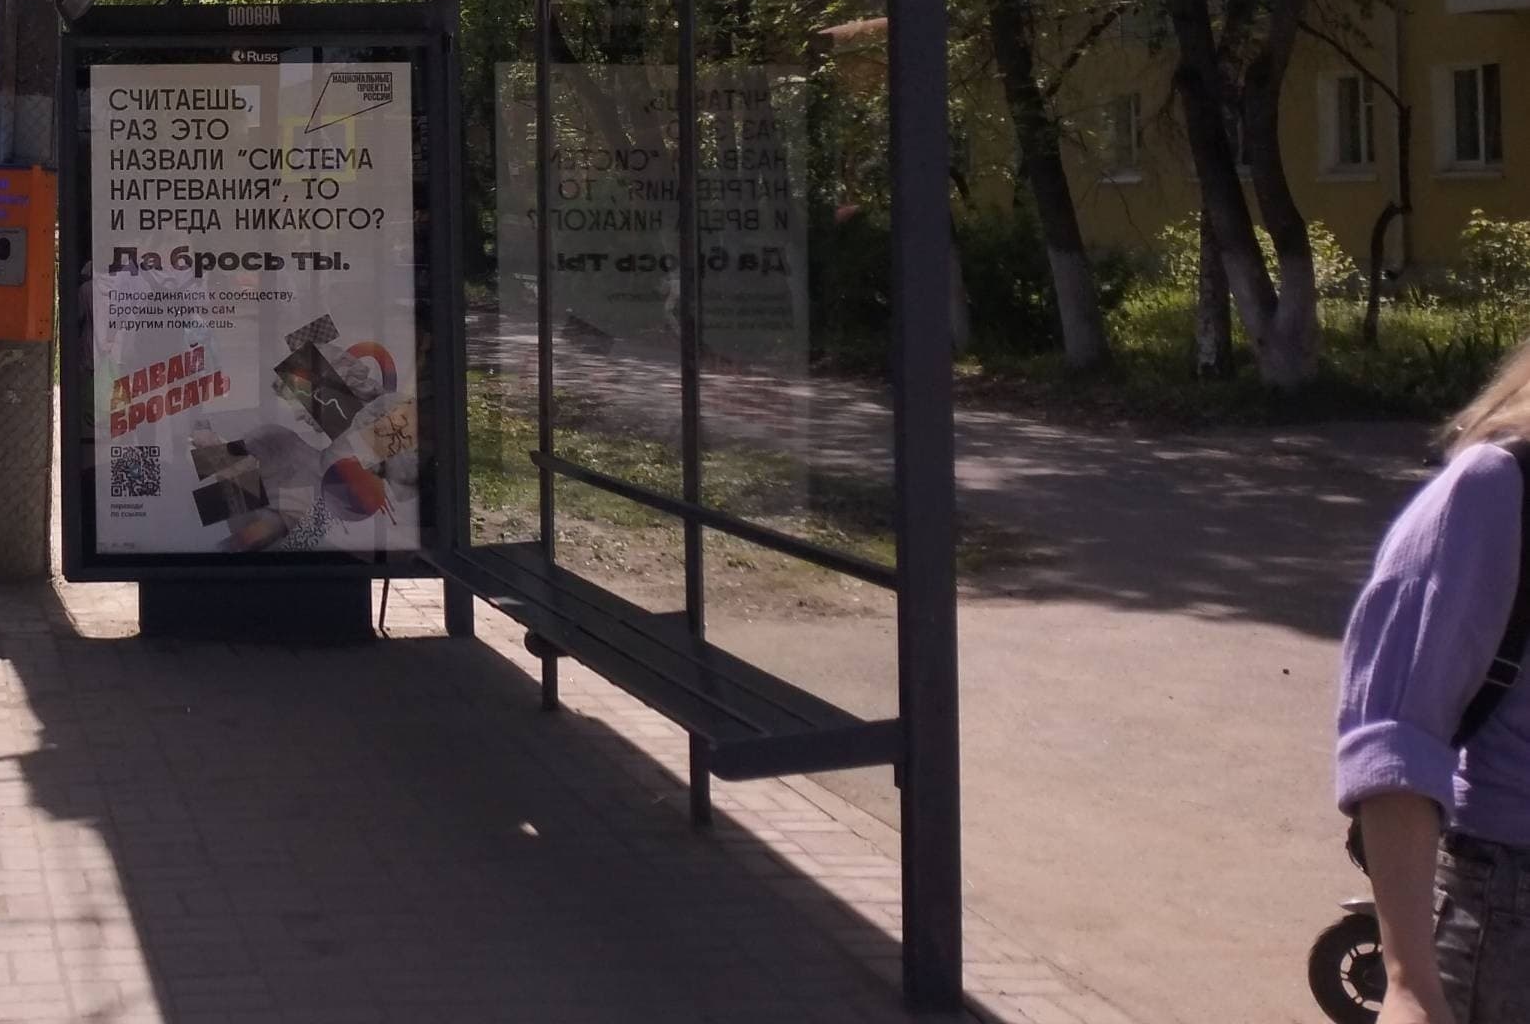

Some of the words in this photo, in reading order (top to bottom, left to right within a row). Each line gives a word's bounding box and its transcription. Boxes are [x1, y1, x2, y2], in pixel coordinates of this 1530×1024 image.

[246, 50, 278, 62] Russ
[357, 83, 391, 92] ПРОЕКТЫ
[108, 88, 254, 113] СЧИТАЕШЬ,
[110, 118, 158, 141] РАЗ
[171, 118, 229, 141] ЭТО
[110, 148, 224, 171] НАЗВАЛИ
[304, 178, 339, 200] ТО
[111, 209, 125, 231] И
[139, 208, 222, 234] ВРЕДА
[235, 207, 385, 230] НИКАКОГО?
[108, 246, 163, 276] Да
[170, 245, 285, 278] брось
[291, 251, 350, 271] ты.
[109, 289, 206, 303] Присоединяйся
[209, 291, 216, 301] к
[109, 304, 164, 318] Бросишь
[167, 305, 209, 317] курить
[211, 306, 236, 315] сам
[109, 320, 116, 329] и
[120, 320, 164, 332] другим
[110, 342, 205, 410] ДАВАЙ
[110, 370, 231, 439] БРОСАТЬ
